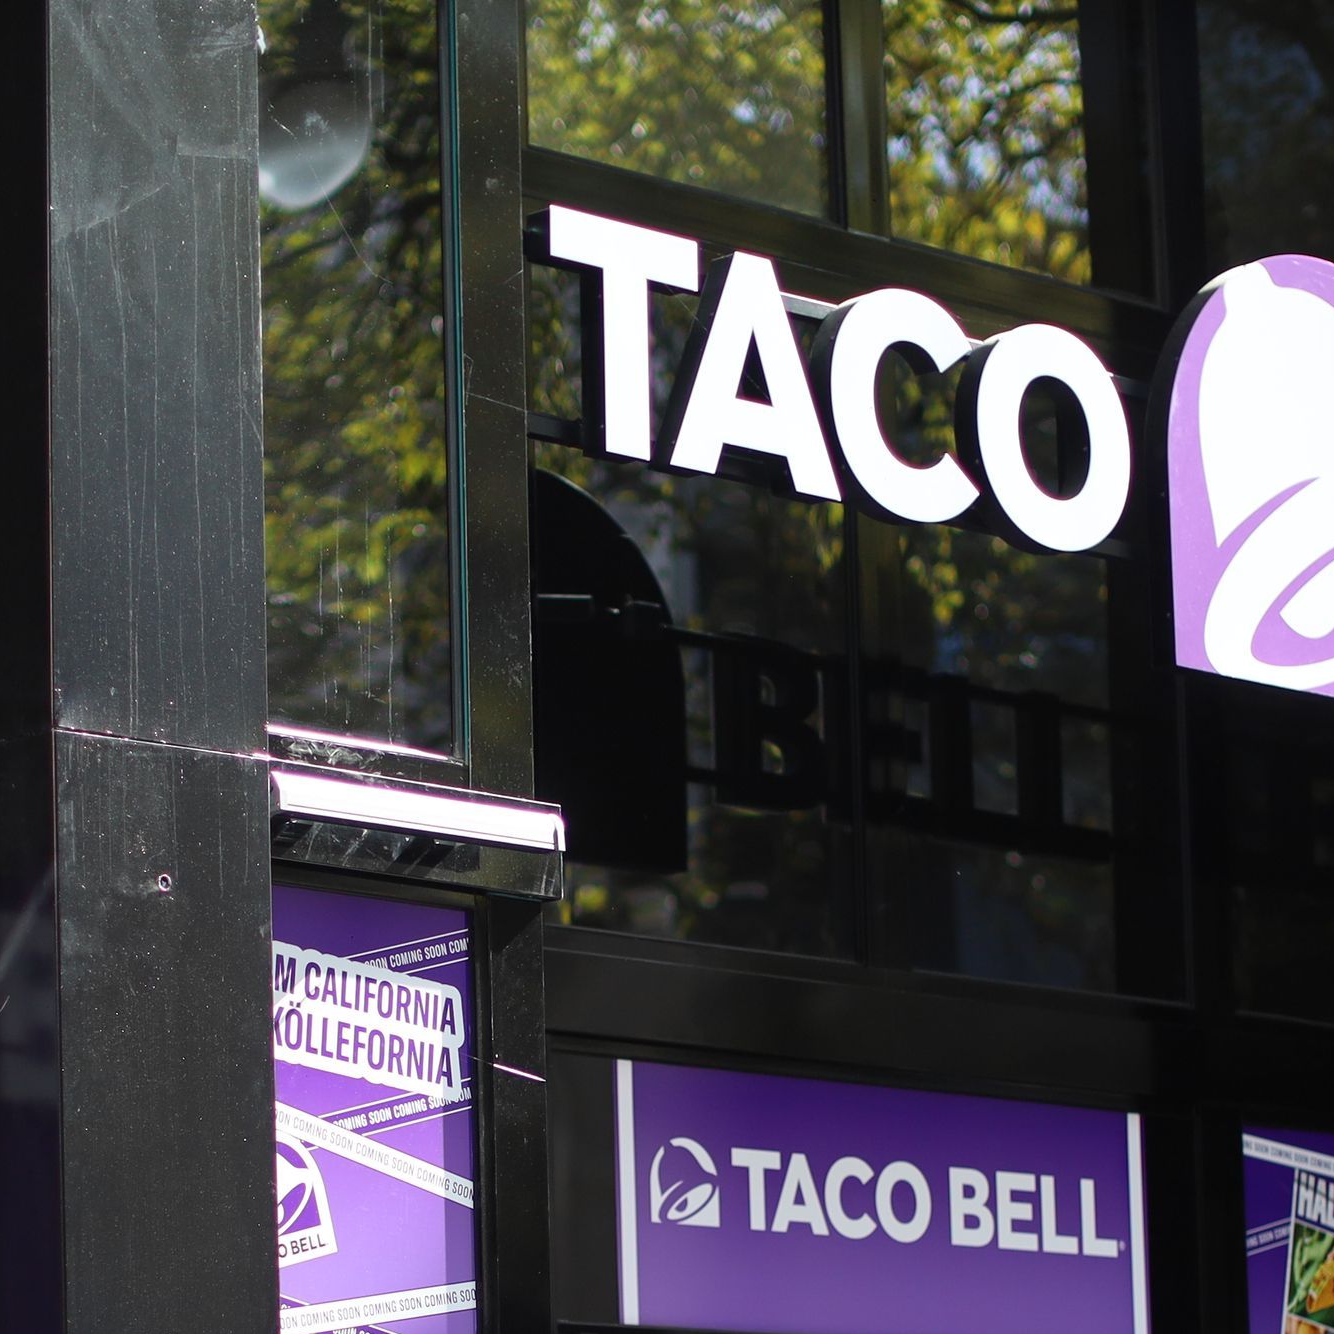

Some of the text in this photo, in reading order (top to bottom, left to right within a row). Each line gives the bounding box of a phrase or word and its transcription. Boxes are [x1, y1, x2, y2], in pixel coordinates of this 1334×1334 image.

[550, 205, 1132, 552] TACO
[390, 949, 423, 968] COMING
[424, 943, 447, 959] SOON
[449, 937, 469, 954] COM
[304, 962, 456, 1036] CALIFORNIA
[368, 1108, 392, 1125] SOON
[393, 1098, 427, 1118] COMING
[276, 1111, 291, 1125] ON
[293, 1117, 327, 1141] COMING
[330, 1131, 353, 1152] SOON
[355, 1142, 389, 1166] COMING
[391, 1156, 415, 1177] SOON
[416, 1167, 450, 1191] COMING
[731, 1147, 1119, 1258] TACO BELL
[291, 1234, 326, 1255] BELL
[280, 1288, 476, 1330] OON COMING SOON COMING SOON COMING SOO
